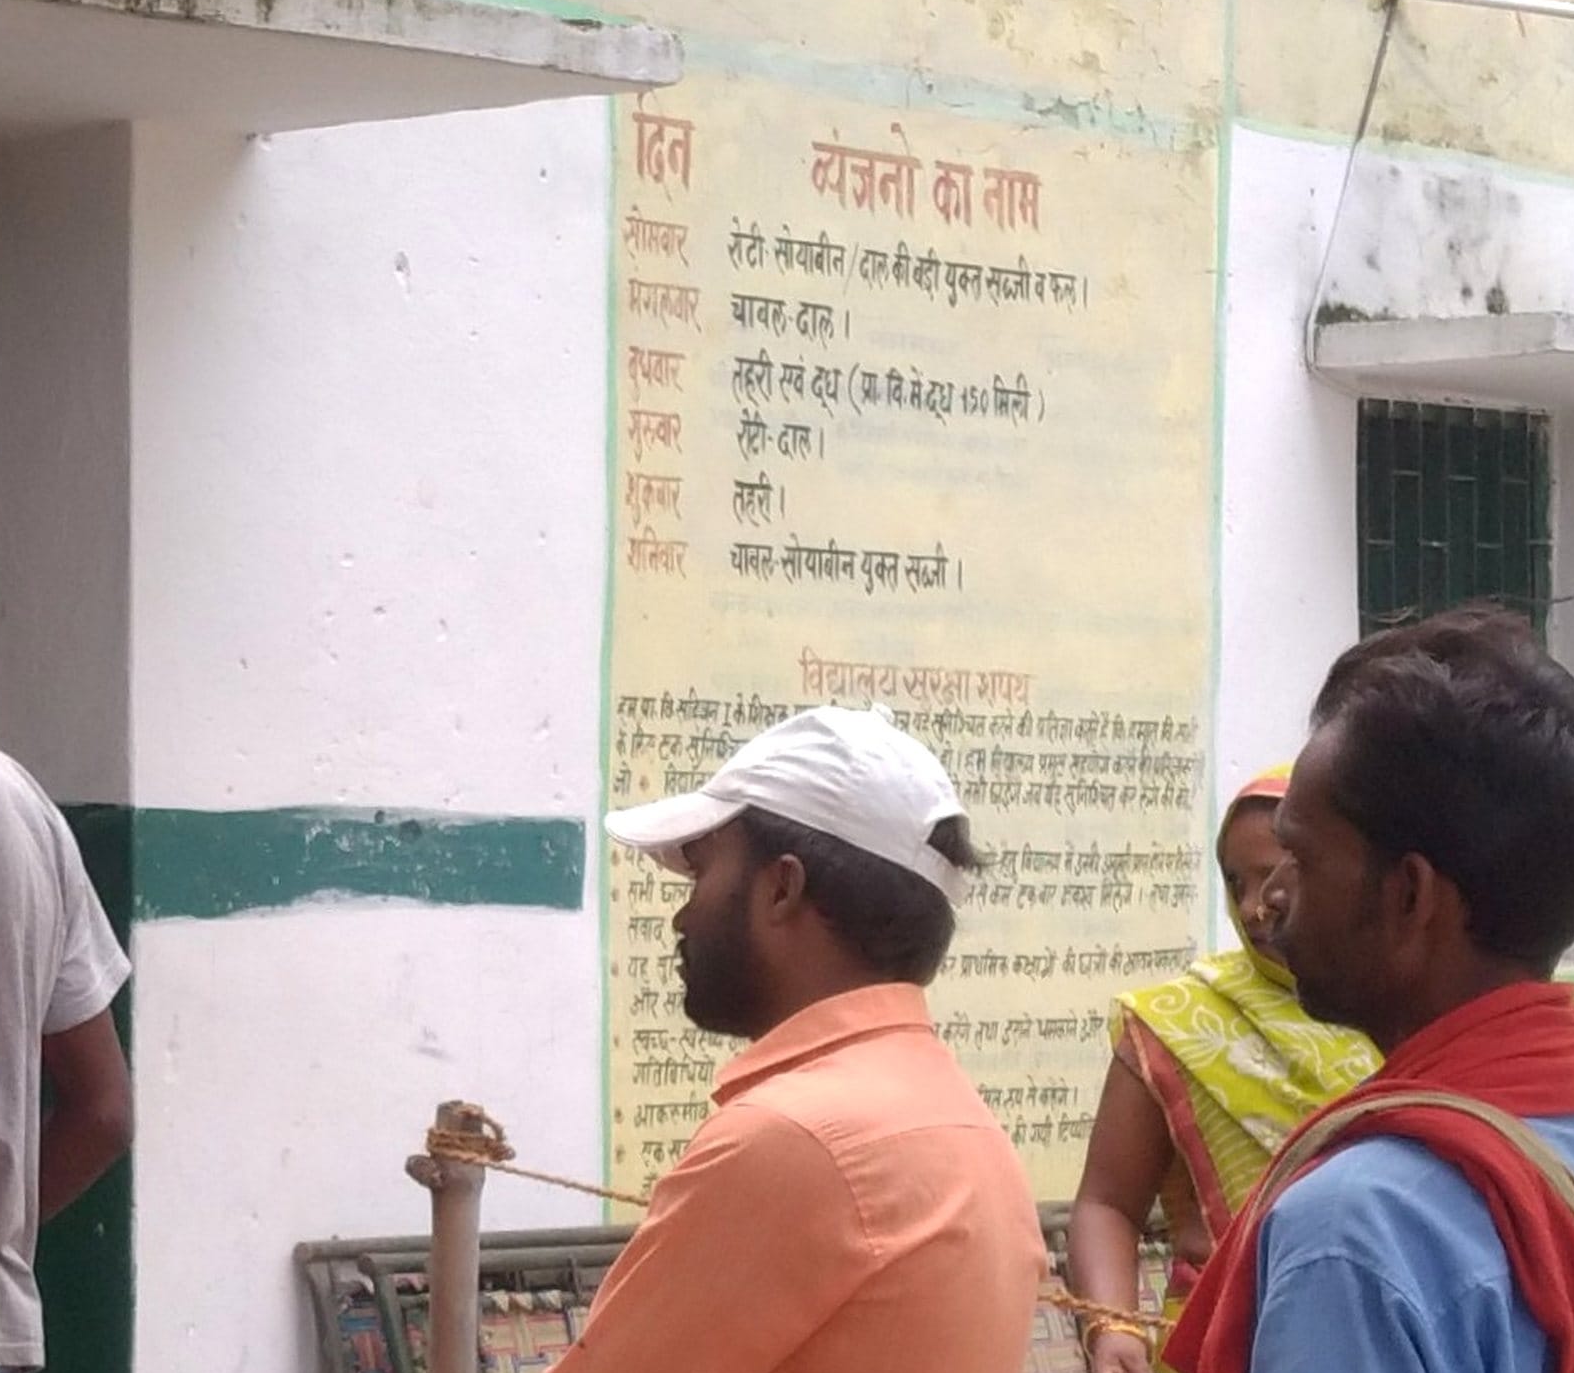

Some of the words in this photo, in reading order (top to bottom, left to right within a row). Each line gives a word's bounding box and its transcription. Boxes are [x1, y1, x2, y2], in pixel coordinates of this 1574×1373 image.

[632, 92, 696, 204] दिन
[933, 160, 974, 228] का
[982, 167, 1043, 232] नाम
